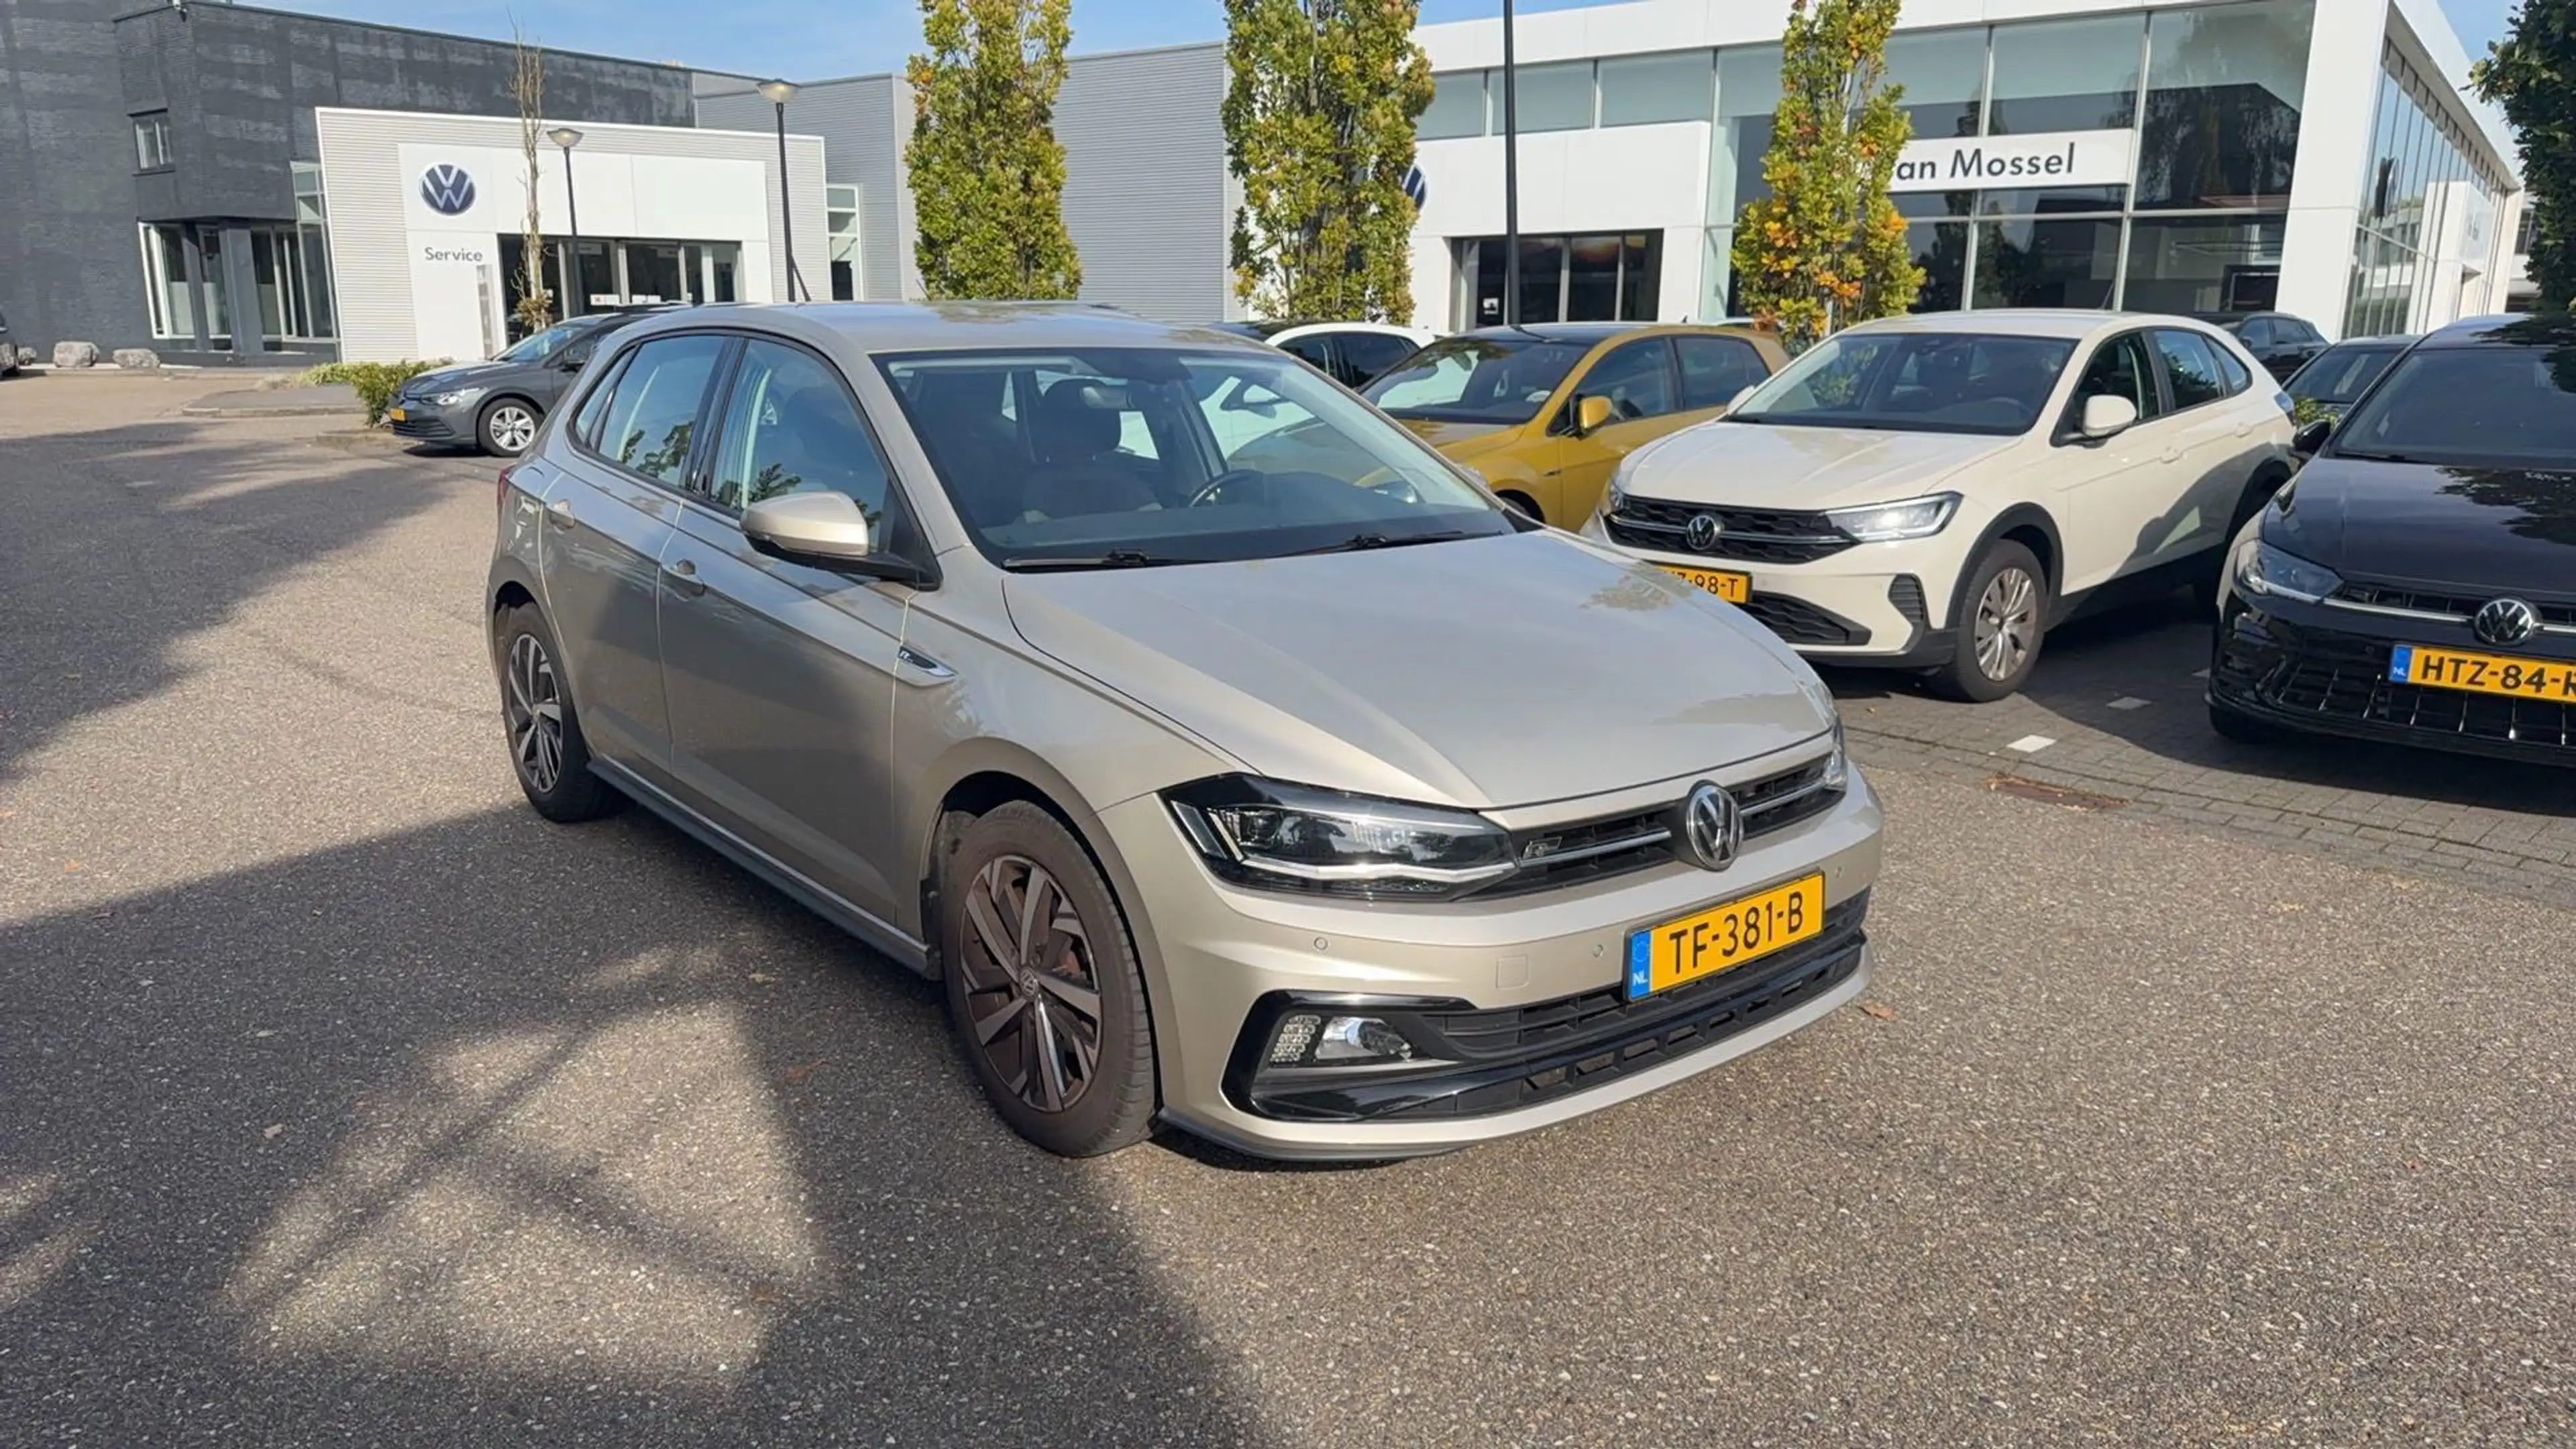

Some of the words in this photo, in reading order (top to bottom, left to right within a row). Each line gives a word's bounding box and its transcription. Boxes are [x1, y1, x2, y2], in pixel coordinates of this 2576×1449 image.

[1896, 160, 1937, 180] an
[1950, 142, 2074, 178] Mossel
[425, 247, 482, 262] Service
[1669, 891, 1803, 974] TF-381-B
[1632, 971, 1648, 985] NL
